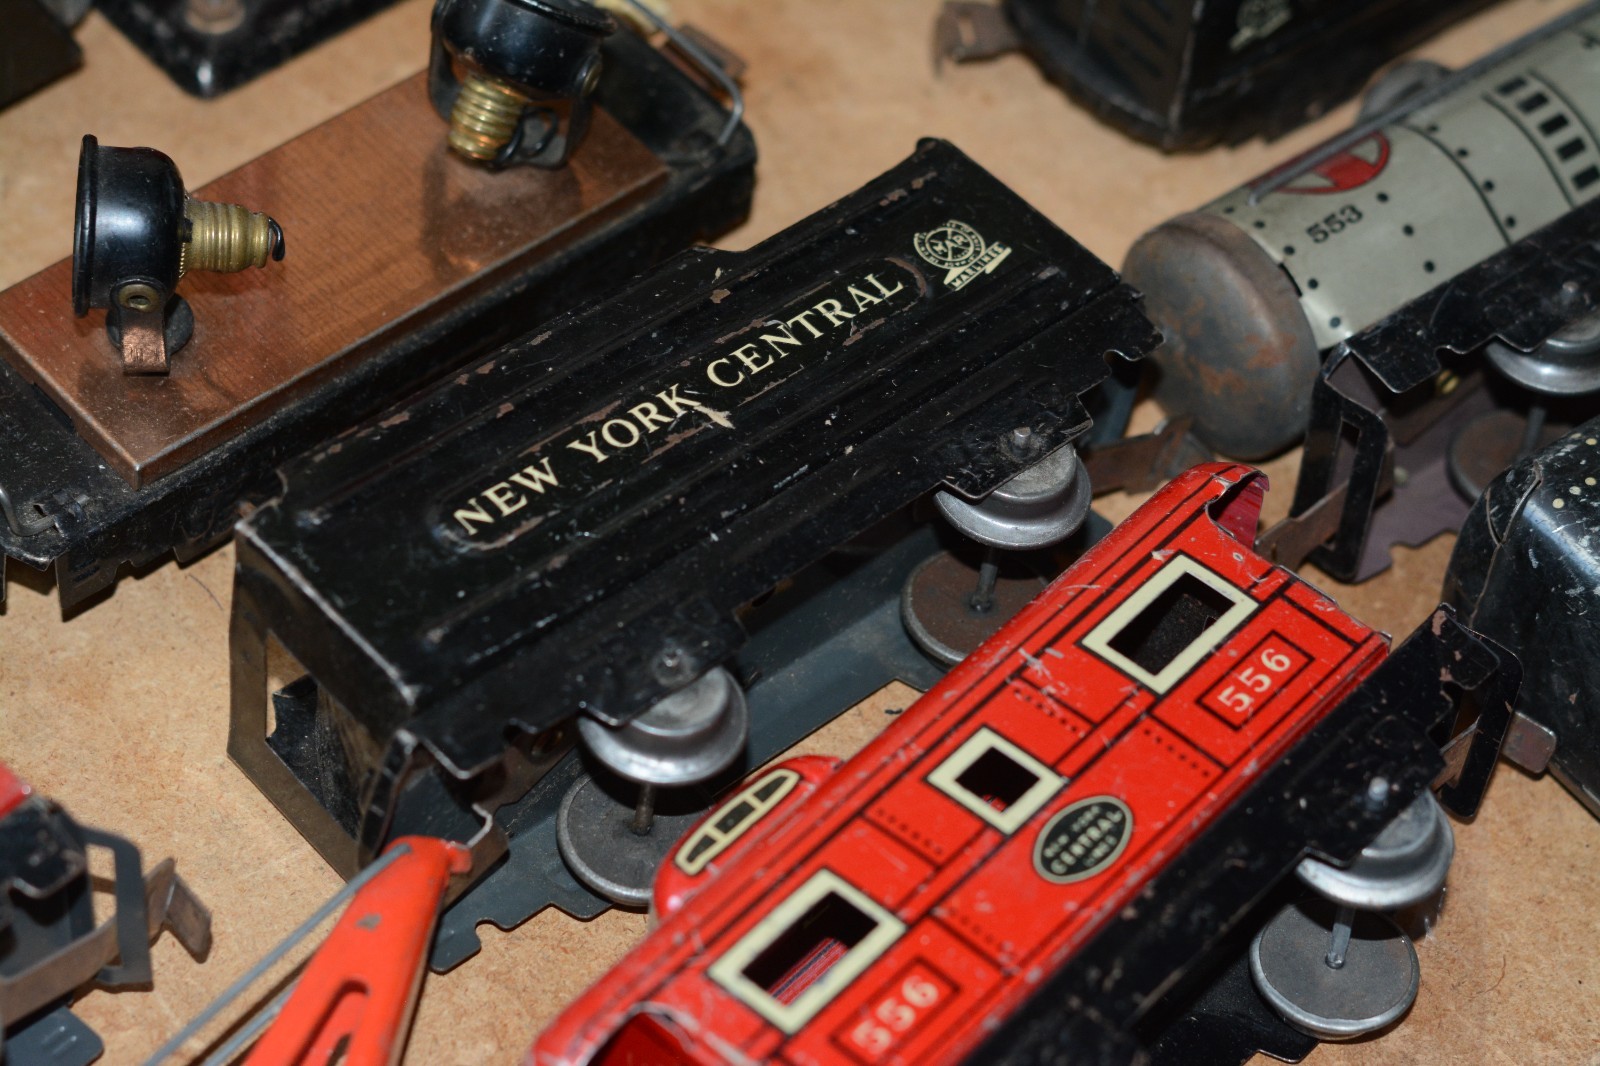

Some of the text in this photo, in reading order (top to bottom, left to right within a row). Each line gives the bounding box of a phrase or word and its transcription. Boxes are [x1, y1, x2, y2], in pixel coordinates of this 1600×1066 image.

[1306, 205, 1363, 243] 553
[452, 273, 903, 535] NEW YORK CENTRAL
[1217, 648, 1291, 712] 556
[852, 975, 938, 1055] 556
